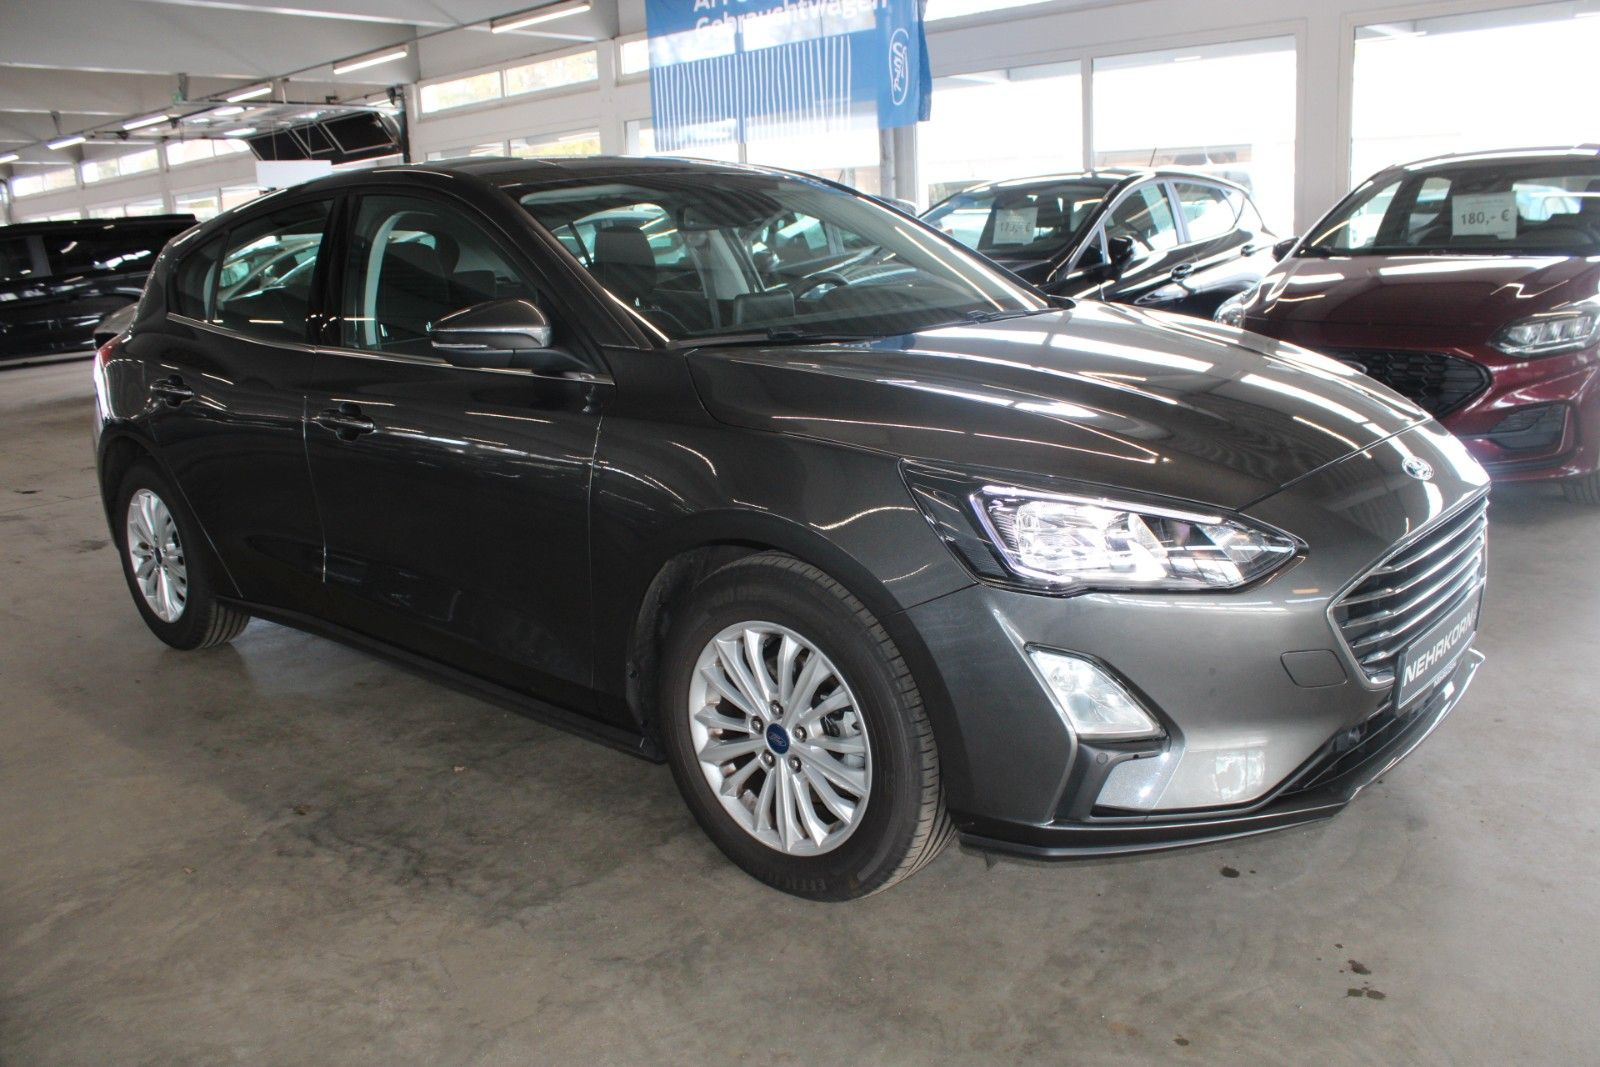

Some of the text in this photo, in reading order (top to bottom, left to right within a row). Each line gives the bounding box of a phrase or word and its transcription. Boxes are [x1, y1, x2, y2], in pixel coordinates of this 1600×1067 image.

[695, 0, 888, 37] Gebrahtwagen
[1501, 208, 1511, 222] €
[1403, 608, 1475, 687] NEHRKORN
